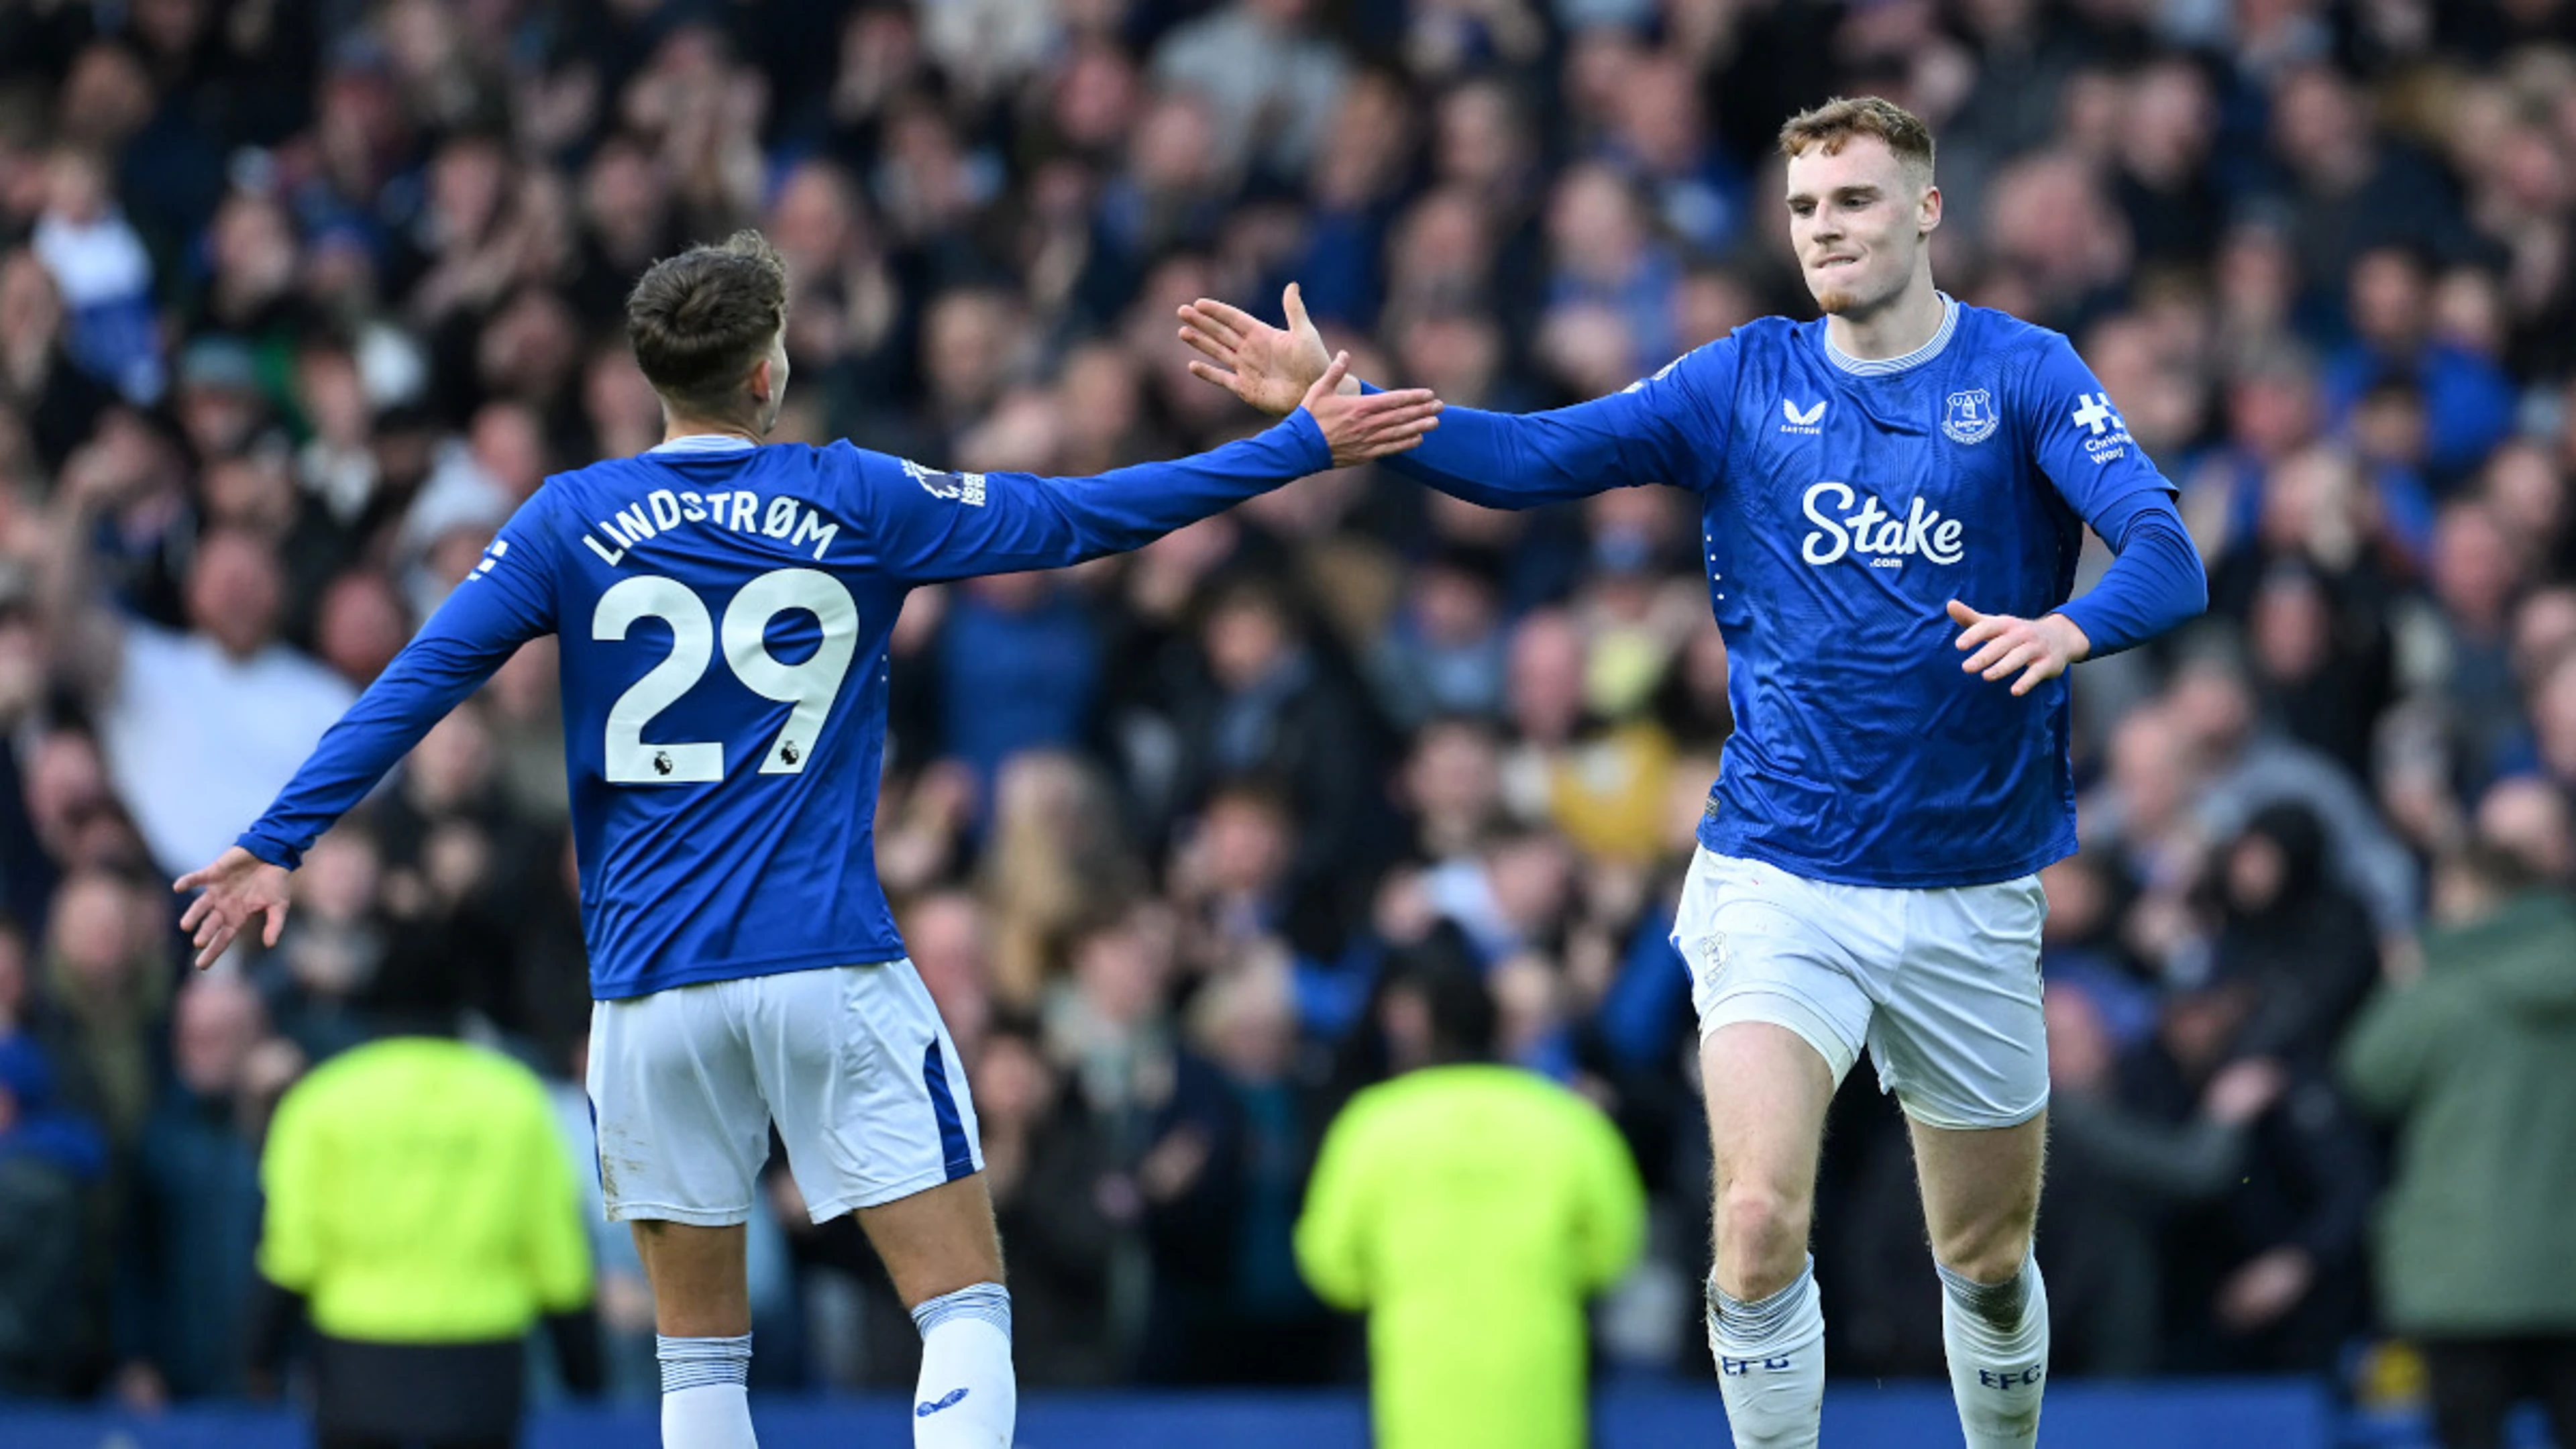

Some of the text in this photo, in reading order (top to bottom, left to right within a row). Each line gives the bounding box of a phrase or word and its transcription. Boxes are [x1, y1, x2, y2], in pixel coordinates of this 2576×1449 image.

[2090, 446, 2124, 464] Ward
[582, 489, 839, 567] LINDSTRØM
[1802, 482, 1964, 565] Stake
[1869, 557, 1902, 568] .com
[592, 568, 858, 782] 29
[1978, 1364, 2041, 1390] EFC
